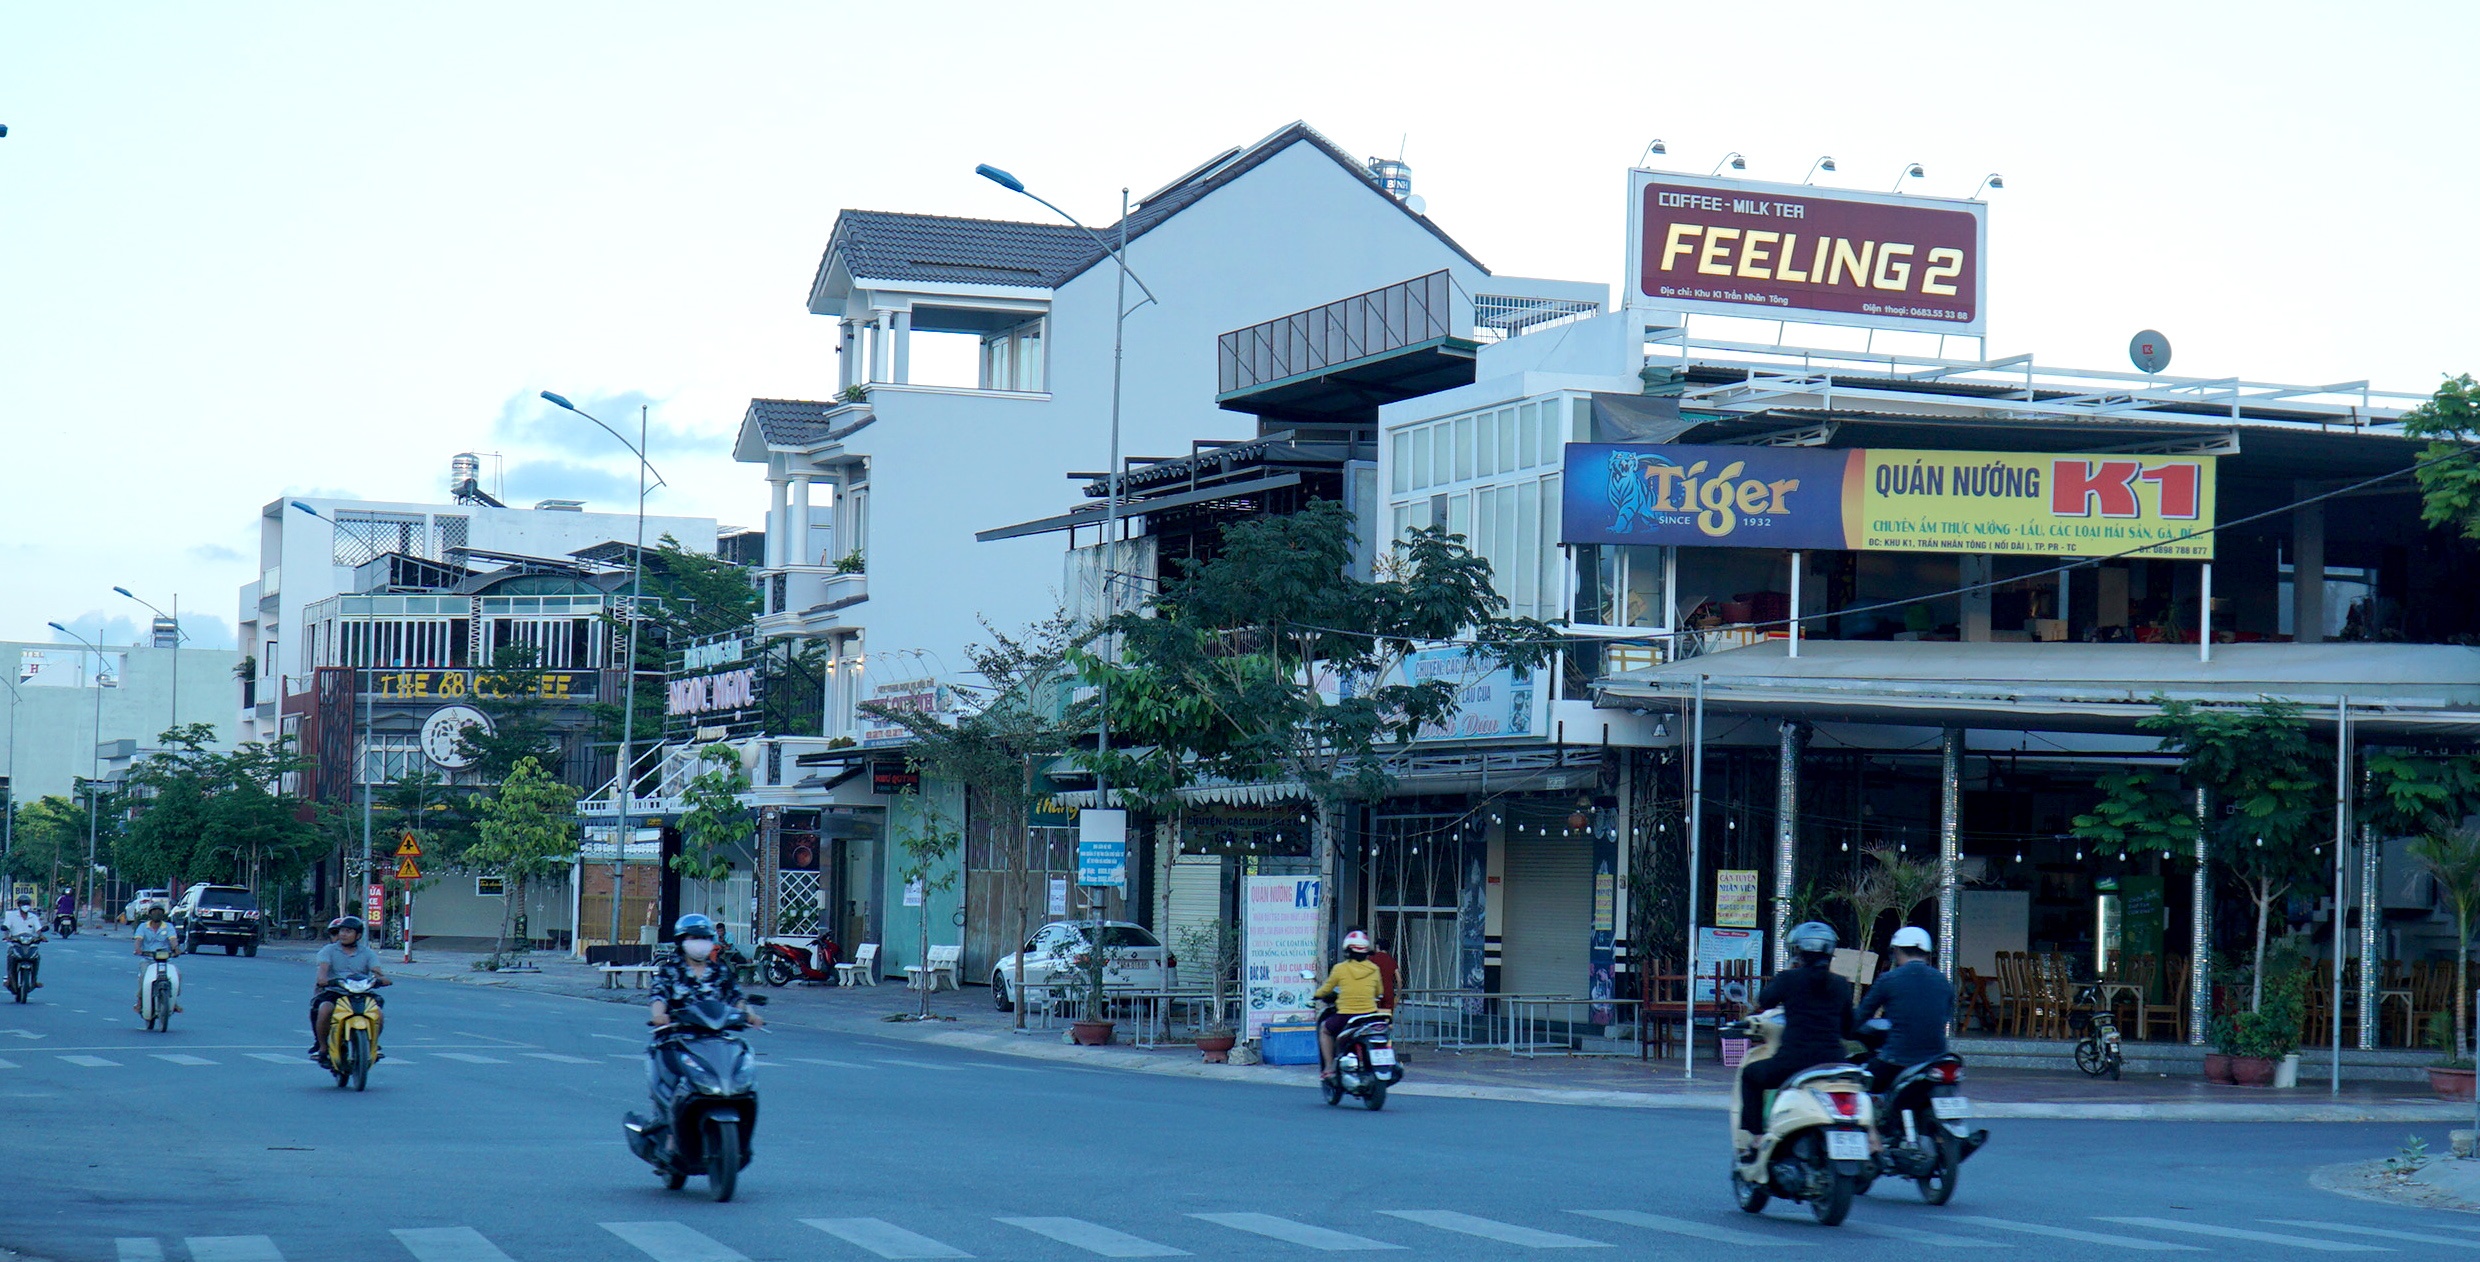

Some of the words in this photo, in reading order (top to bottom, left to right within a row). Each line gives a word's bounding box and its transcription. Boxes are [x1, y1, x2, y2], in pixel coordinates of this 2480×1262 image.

[1658, 191, 1722, 212] COFFEE
[1733, 197, 1770, 217] MILK
[1774, 203, 1804, 220] TEA
[1659, 223, 1915, 291] FEELING
[1921, 247, 1964, 296] 2
[1660, 286, 1675, 297] Địa
[1677, 286, 1692, 297] chỉ:
[1694, 289, 1711, 298] Khu
[1724, 289, 1742, 301] Trần
[1744, 292, 1766, 303] Nhân
[1769, 294, 1789, 307] Tông
[1862, 303, 1882, 314] Điện
[1884, 304, 1909, 317] thoại:
[1944, 309, 1955, 319] 33
[1957, 311, 1968, 320] 88
[1644, 460, 1800, 537] Tiger
[1876, 459, 1945, 499] QUÁN
[1952, 460, 2041, 499] NƯỚNG
[2050, 458, 2201, 520] K1
[1658, 514, 1691, 526] SINCE
[1742, 517, 1772, 528] 1932
[1872, 517, 1916, 533] CHUYÊN
[1941, 520, 1971, 538] THỰC
[1973, 519, 2011, 536] NƯỚNG
[2049, 519, 2072, 537] CÁC
[2074, 525, 2100, 541] LOẠI
[1868, 538, 1883, 547] ĐC:
[1884, 538, 1901, 547] KHU
[1918, 536, 1939, 548] TRẦN
[1941, 537, 1963, 549] NHÂN
[1965, 538, 1987, 550] TÔNG
[2047, 542, 2059, 551] PR
[2066, 543, 2077, 552] TC
[1445, 654, 1460, 675] CÁC
[381, 672, 430, 699] THE
[438, 671, 466, 699] 68
[473, 674, 572, 700] COEE
[669, 676, 712, 726] NGỌC
[712, 666, 756, 721] NGỌC
[1477, 685, 1492, 703] CUA
[15, 887, 34, 895] BIDA
[369, 886, 382, 896] ỬA
[1251, 883, 1269, 903] QUÁN
[1270, 884, 1293, 903] NƯỚNG
[1295, 880, 1321, 908] K1
